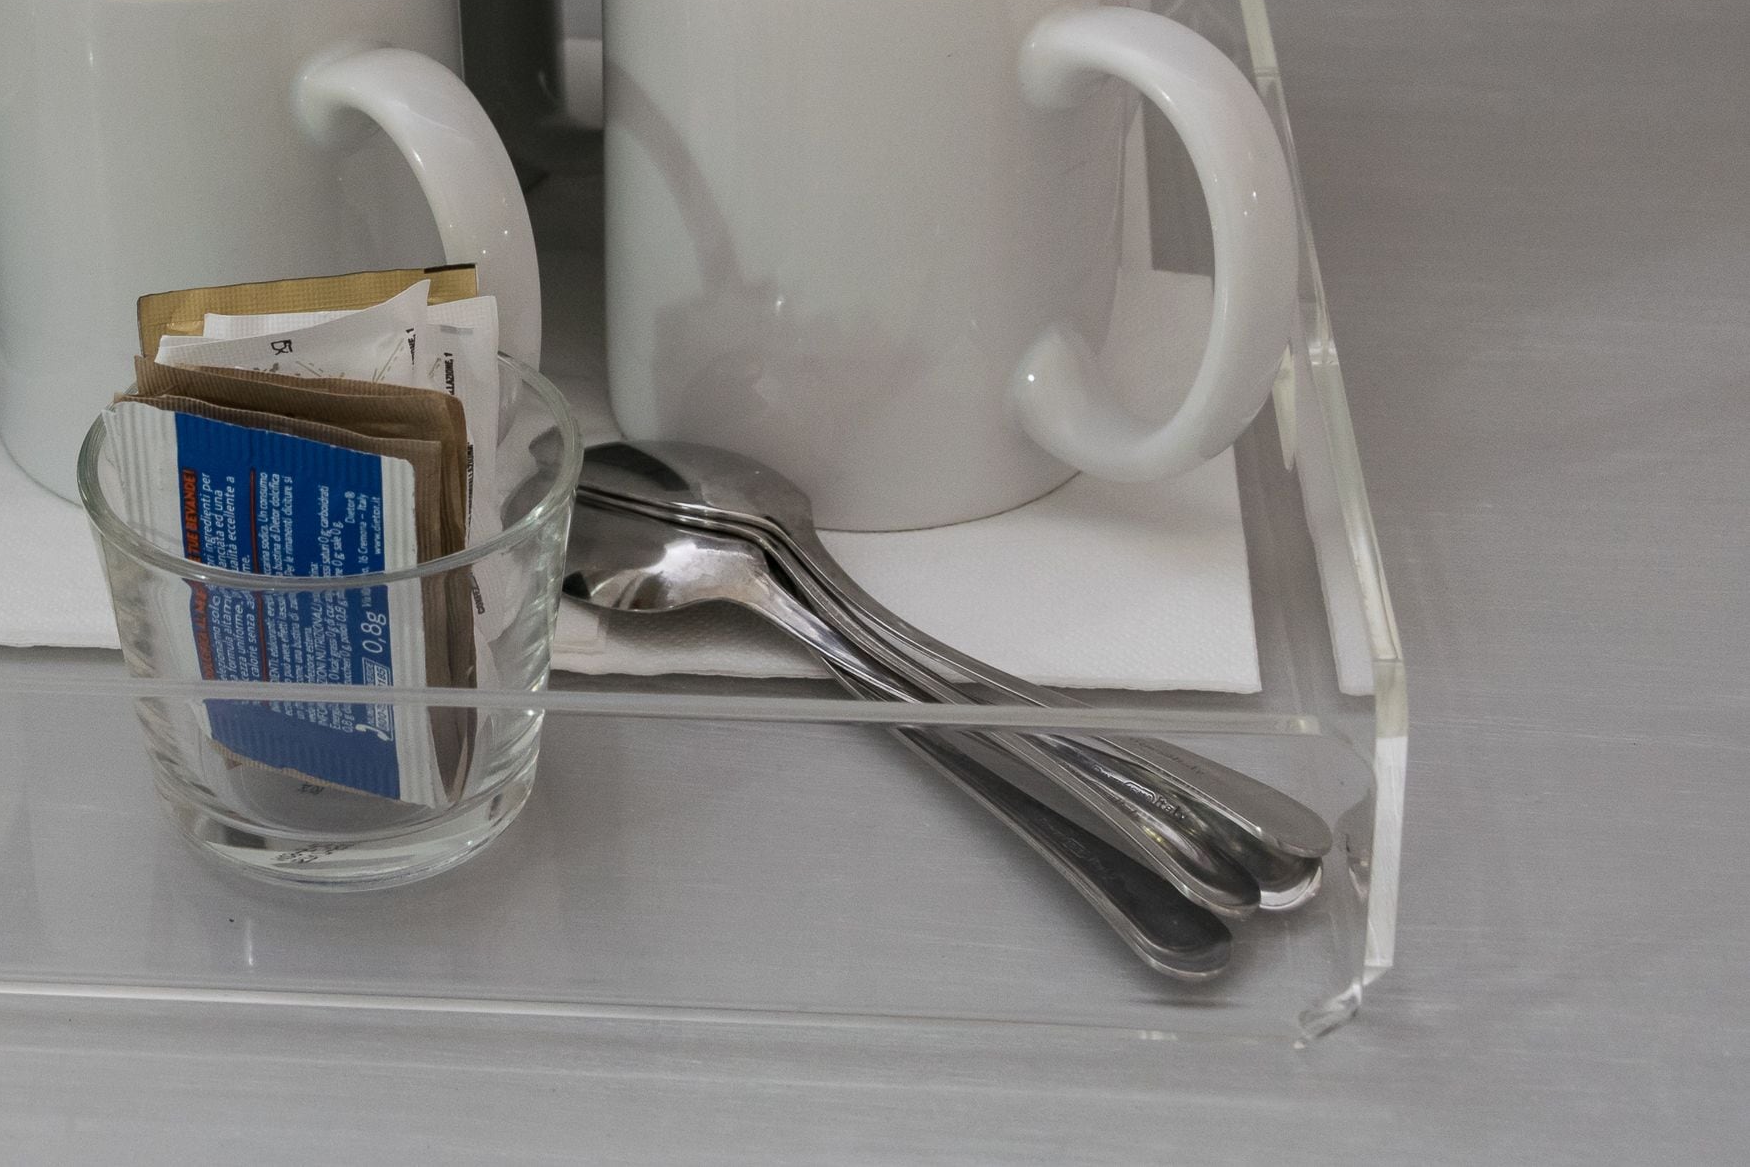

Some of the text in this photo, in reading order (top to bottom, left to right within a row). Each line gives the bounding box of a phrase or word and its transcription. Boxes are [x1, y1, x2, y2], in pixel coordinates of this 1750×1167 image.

[202, 472, 213, 492] per
[260, 472, 268, 509] consumo
[268, 474, 280, 506] dolcifica
[183, 470, 198, 530] BEVANDE!
[214, 490, 223, 510] una
[224, 486, 236, 540] eccellente
[280, 486, 292, 516] diciture
[318, 484, 329, 528] carboidrati
[357, 493, 368, 511] Italy
[200, 494, 217, 552] ingredienti
[214, 514, 224, 528] ed
[258, 511, 268, 522] Un
[270, 508, 280, 533] Dietor
[372, 496, 381, 554] www.dietor.it
[186, 532, 200, 553] TUE
[258, 524, 270, 550] sodica.
[281, 517, 292, 554] rimanenti
[330, 536, 342, 551] sale
[358, 521, 368, 554] Cremona
[272, 544, 282, 570] bustina
[246, 614, 256, 644] senza
[360, 612, 387, 654] 0,8g
[224, 636, 238, 672] formula
[248, 646, 260, 677] calorie
